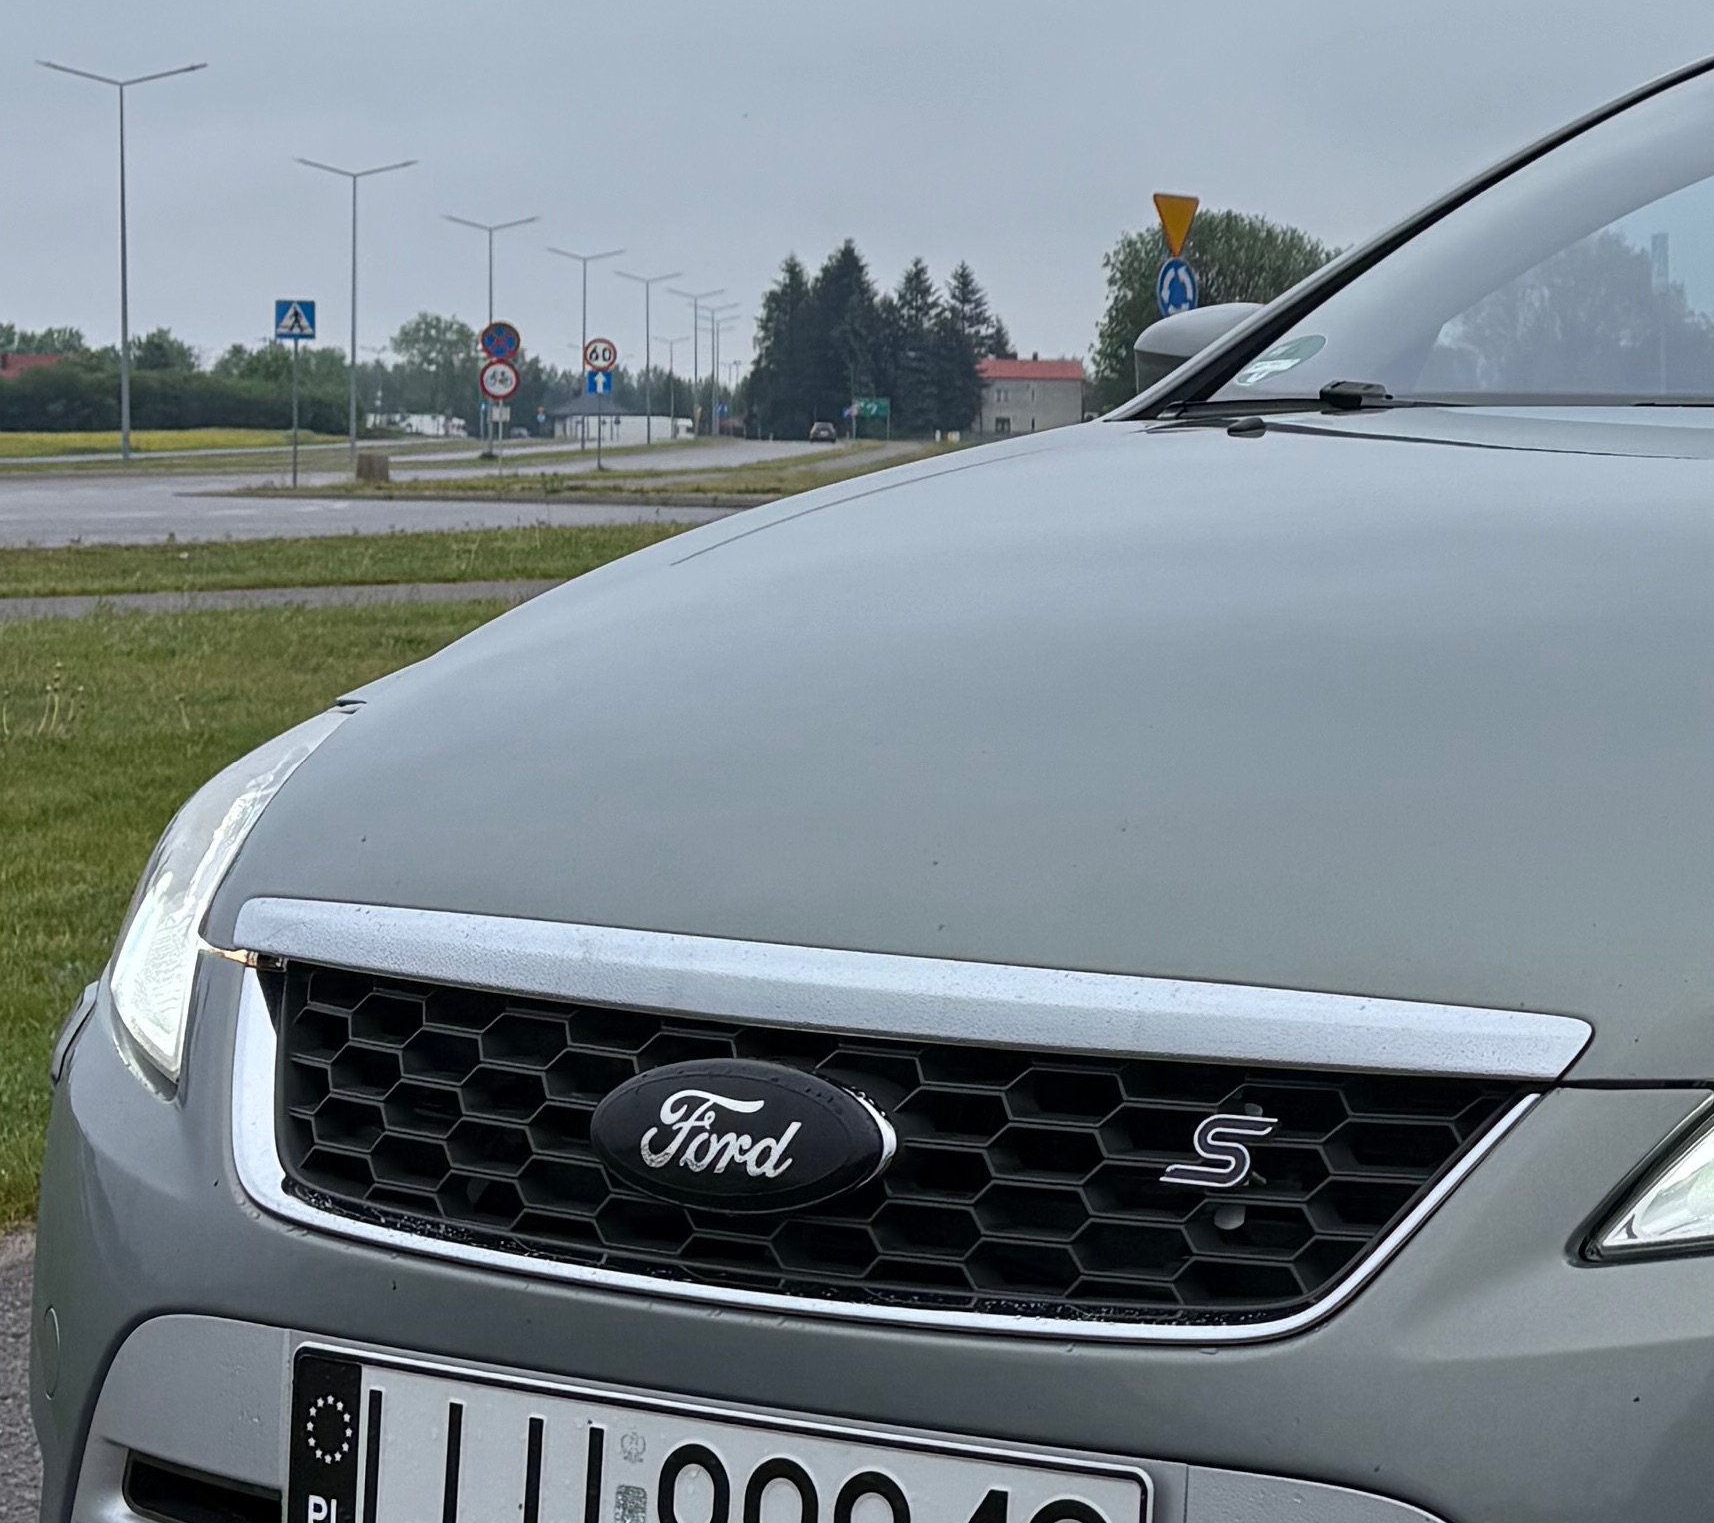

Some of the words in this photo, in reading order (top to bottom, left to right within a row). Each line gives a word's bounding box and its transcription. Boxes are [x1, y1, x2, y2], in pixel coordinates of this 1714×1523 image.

[589, 345, 612, 362] 60
[640, 1088, 803, 1179] Ford
[1158, 1113, 1280, 1189] S
